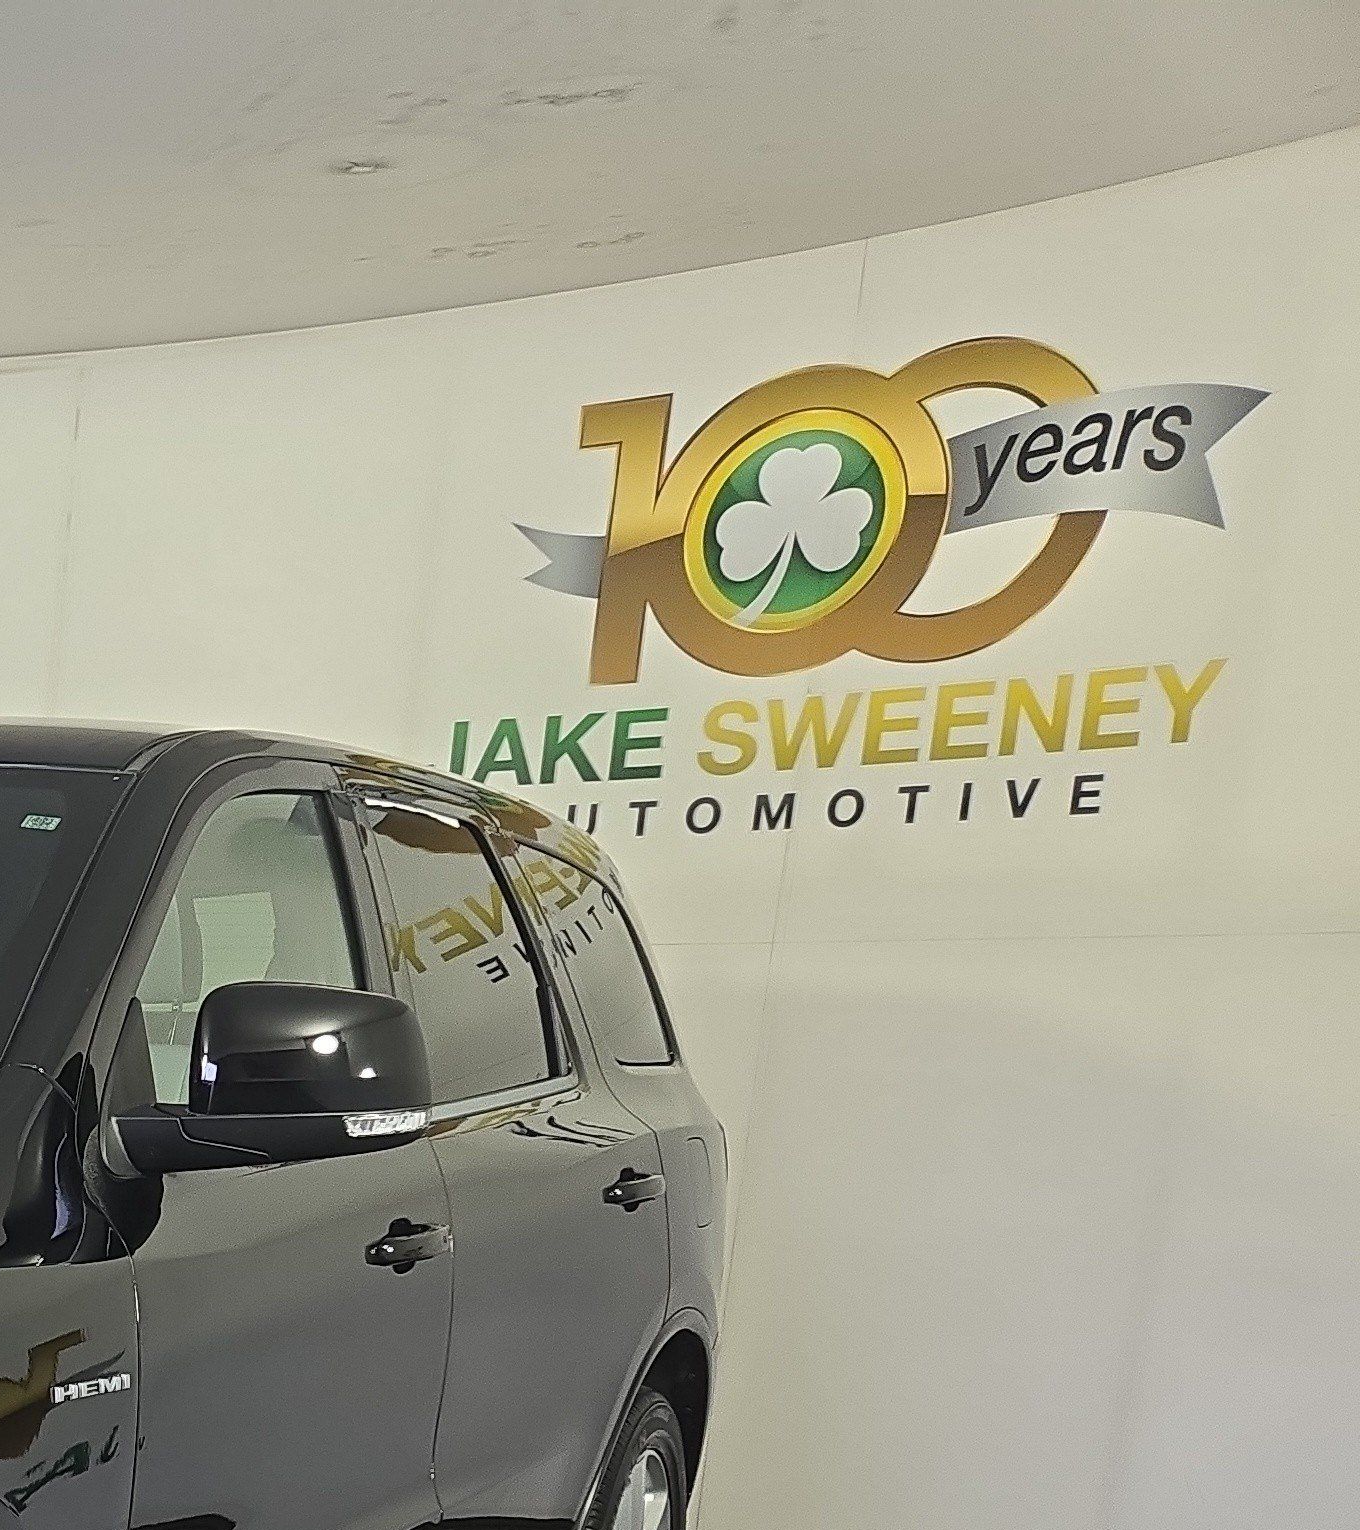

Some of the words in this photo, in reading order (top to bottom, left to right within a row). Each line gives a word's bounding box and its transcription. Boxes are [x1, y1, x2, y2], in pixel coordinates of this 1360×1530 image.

[578, 336, 1109, 686] 100
[962, 403, 1193, 517] years
[696, 658, 1229, 775] SWEENEY
[565, 774, 1107, 838] UTOMOTIVE
[52, 1373, 131, 1404] HEMI
